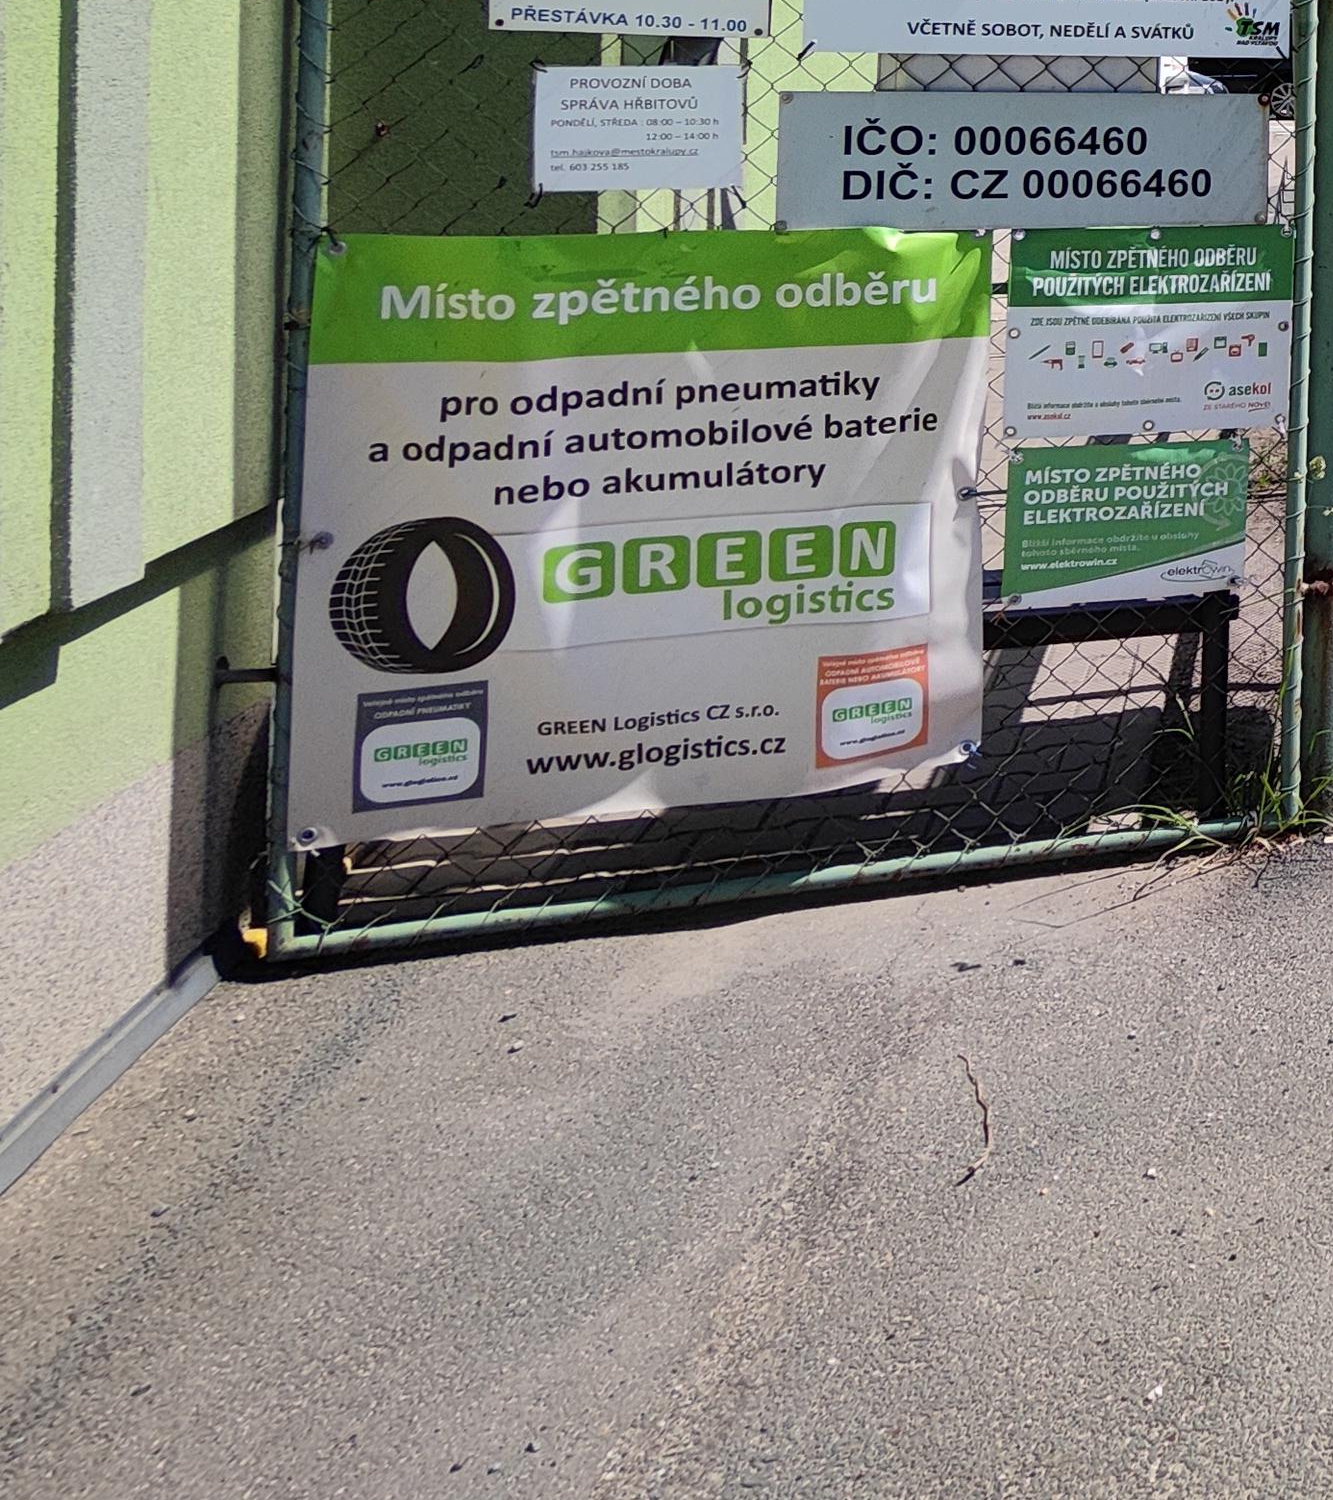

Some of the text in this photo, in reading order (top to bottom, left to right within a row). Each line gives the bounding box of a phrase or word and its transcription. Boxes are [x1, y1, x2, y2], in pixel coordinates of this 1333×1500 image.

[511, 4, 628, 28] PŘESTÁVKA
[635, 14, 683, 29] 10.30
[701, 16, 747, 32] 11.00
[907, 18, 1194, 39] VČETNĚ SOBOT, NEDĚLÍ A SVÁTKŮ
[1240, 20, 1280, 35] TSM
[570, 76, 692, 89] PROVOZNÍ DOBA
[560, 96, 698, 111] SPRÁVA HŘBITOVŮ
[600, 117, 638, 127] STŘEDA
[684, 118, 710, 126] 10:30
[712, 118, 719, 126] h
[646, 132, 719, 141] 12:00 14:00 h
[843, 118, 1148, 157] IČO: 00066460
[569, 163, 587, 171] 603
[590, 163, 609, 171] 255
[612, 162, 629, 171] 185
[842, 162, 1212, 200] DIČ: CZ 00066460
[1050, 245, 1256, 269] MÍSTO ZPĚTNÉHO ODBĚRU
[1032, 269, 1271, 297] POUŽITÝCH ELEKTROZAŘÍZENÍ
[380, 272, 937, 326] Místo zpětného odběru
[440, 370, 880, 422] pro odpadní pneumatiky
[1228, 381, 1271, 396] asekol
[368, 408, 938, 468] a odpadní automobilové baterie
[494, 460, 826, 506] nebo akumulátory
[1025, 463, 1201, 485] MÍSTO ZPĚTNÉHO
[1023, 480, 1228, 505] ODBĚRU POUŽITÝCH
[1023, 500, 1205, 526] ELEKTROZAŘÍZENÍ
[548, 524, 892, 598] GREEN
[1020, 557, 1118, 571] www.elektrowin.cz
[722, 583, 895, 625] logistics
[537, 704, 780, 736] GREEN Logistics CZ s.r.o.
[832, 697, 913, 723] GREEN
[374, 738, 468, 762] GREEN
[526, 735, 786, 775] www.glogistics.cz
